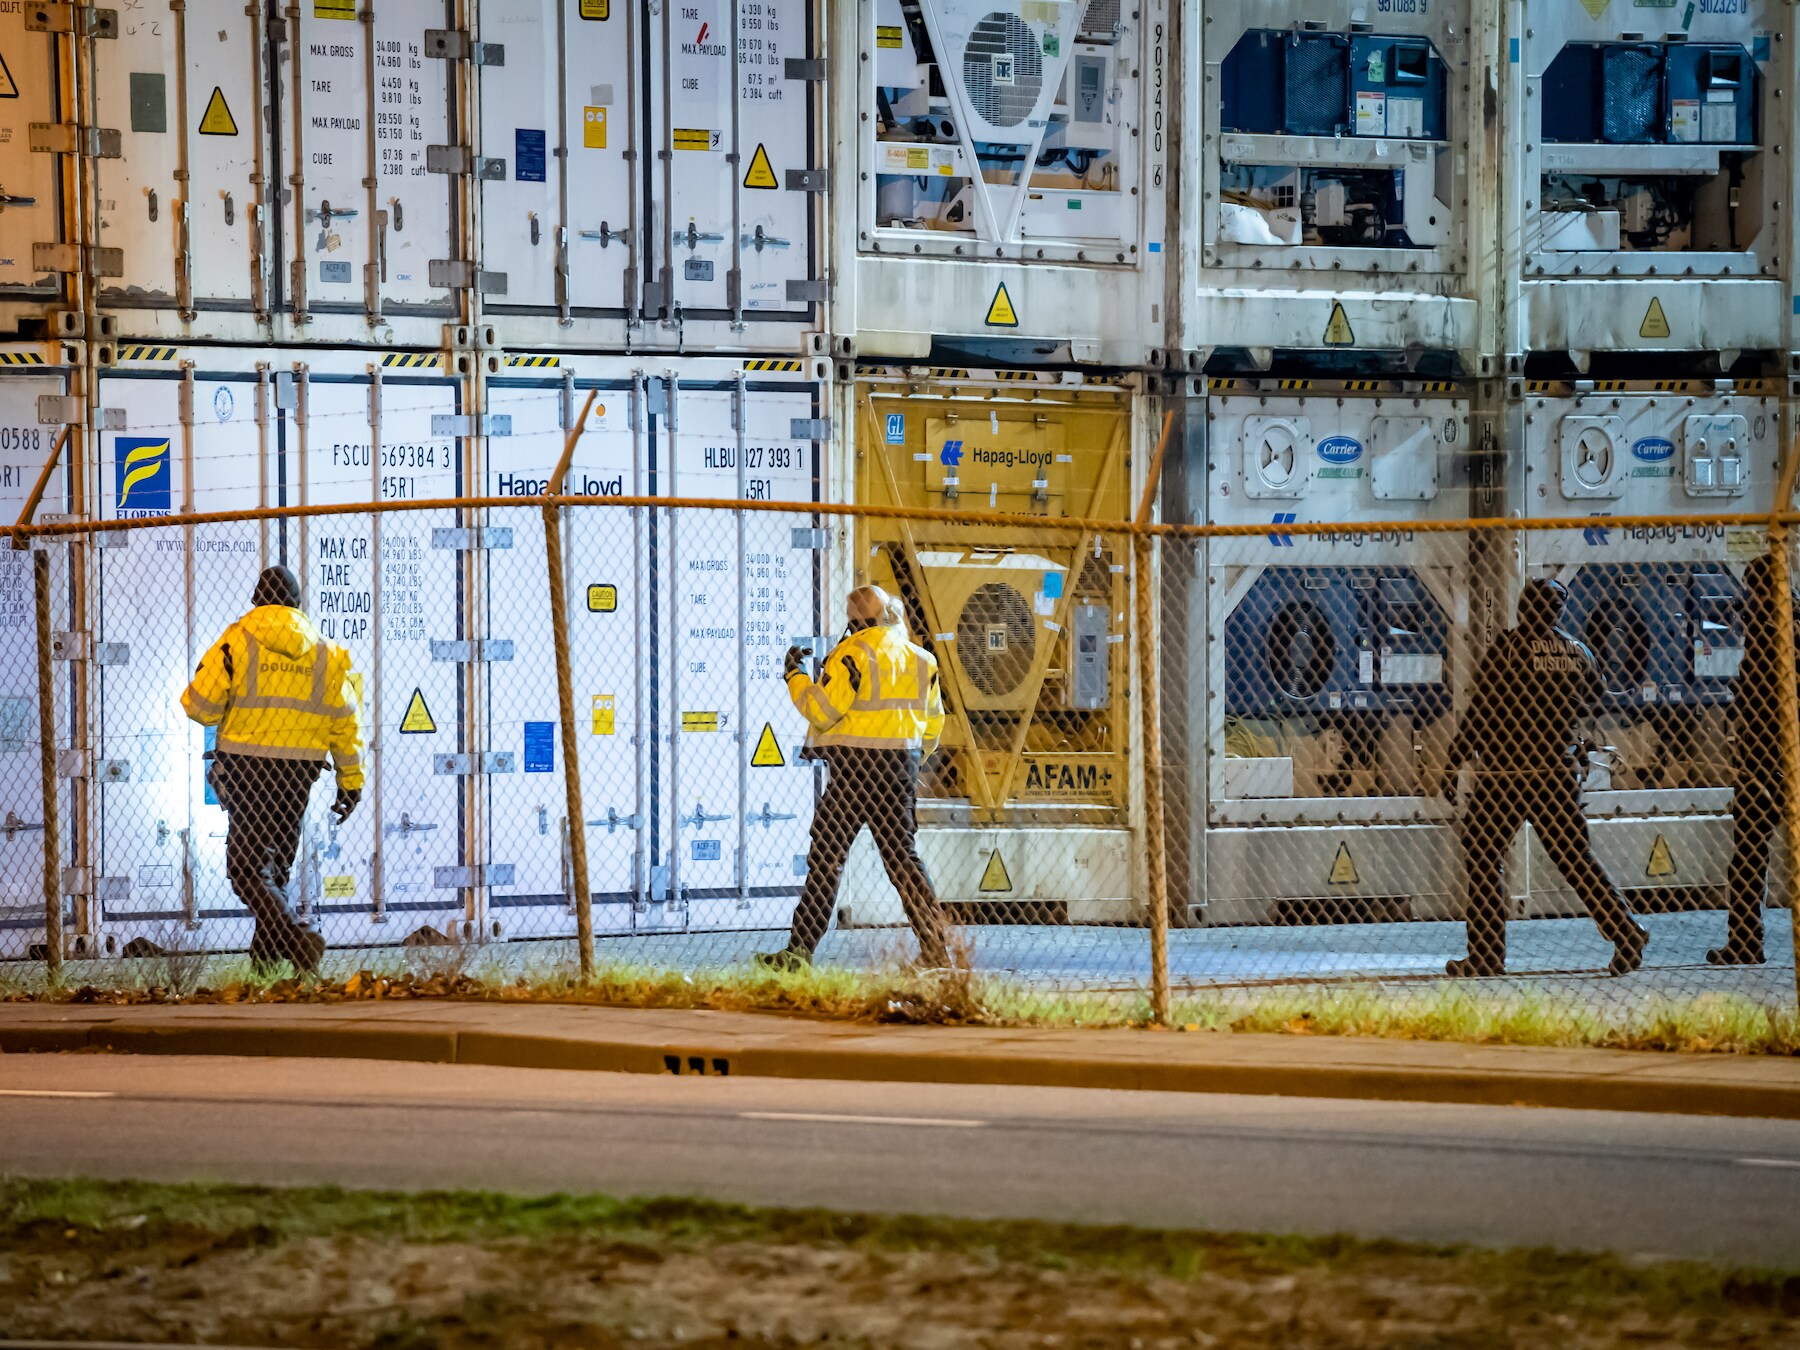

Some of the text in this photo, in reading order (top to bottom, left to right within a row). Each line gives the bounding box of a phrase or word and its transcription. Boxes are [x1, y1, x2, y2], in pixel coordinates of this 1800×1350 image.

[682, 8, 698, 20] TARE
[768, 5, 776, 19] kg
[768, 20, 779, 31] lbs
[376, 41, 418, 57] 34.000 kg
[768, 40, 776, 54] kg
[376, 56, 421, 69] 74.960 lbs
[768, 55, 779, 66] lbs
[311, 81, 331, 93] TARE
[382, 78, 418, 93] 4.450 kg
[682, 79, 699, 90] CUBE
[382, 92, 421, 105] 9.810 lbs
[769, 89, 782, 100] cuft
[1153, 24, 1163, 186] 903400 6
[378, 113, 419, 128] 29.550 kg
[378, 128, 422, 141] 65.150 lbs
[313, 153, 332, 165] CUBE
[383, 149, 403, 161] 67.36
[383, 164, 426, 177] 2.380 cuft
[887, 415, 904, 436] GL
[1, 427, 40, 450] 0588
[334, 444, 450, 468] FSCU 569384 3
[1323, 442, 1357, 456] Carrier
[1637, 443, 1670, 456] Carrier
[705, 447, 736, 468] HLBU
[973, 447, 1052, 469] Hapag-Lloyd
[0, 465, 20, 488] R1
[156, 536, 256, 552] www.lorens.com
[775, 553, 784, 567] kg
[320, 565, 350, 586] TARE
[775, 567, 787, 579] lbs
[690, 594, 707, 606] TARE
[775, 588, 784, 602] kg
[320, 592, 371, 613] PAYLOAD
[775, 601, 786, 612] lbs
[775, 621, 784, 635] kg
[775, 635, 787, 646] lbs
[260, 662, 313, 677] DOUANE
[690, 662, 707, 675] CUBE
[1025, 763, 1113, 790] AFAM+
